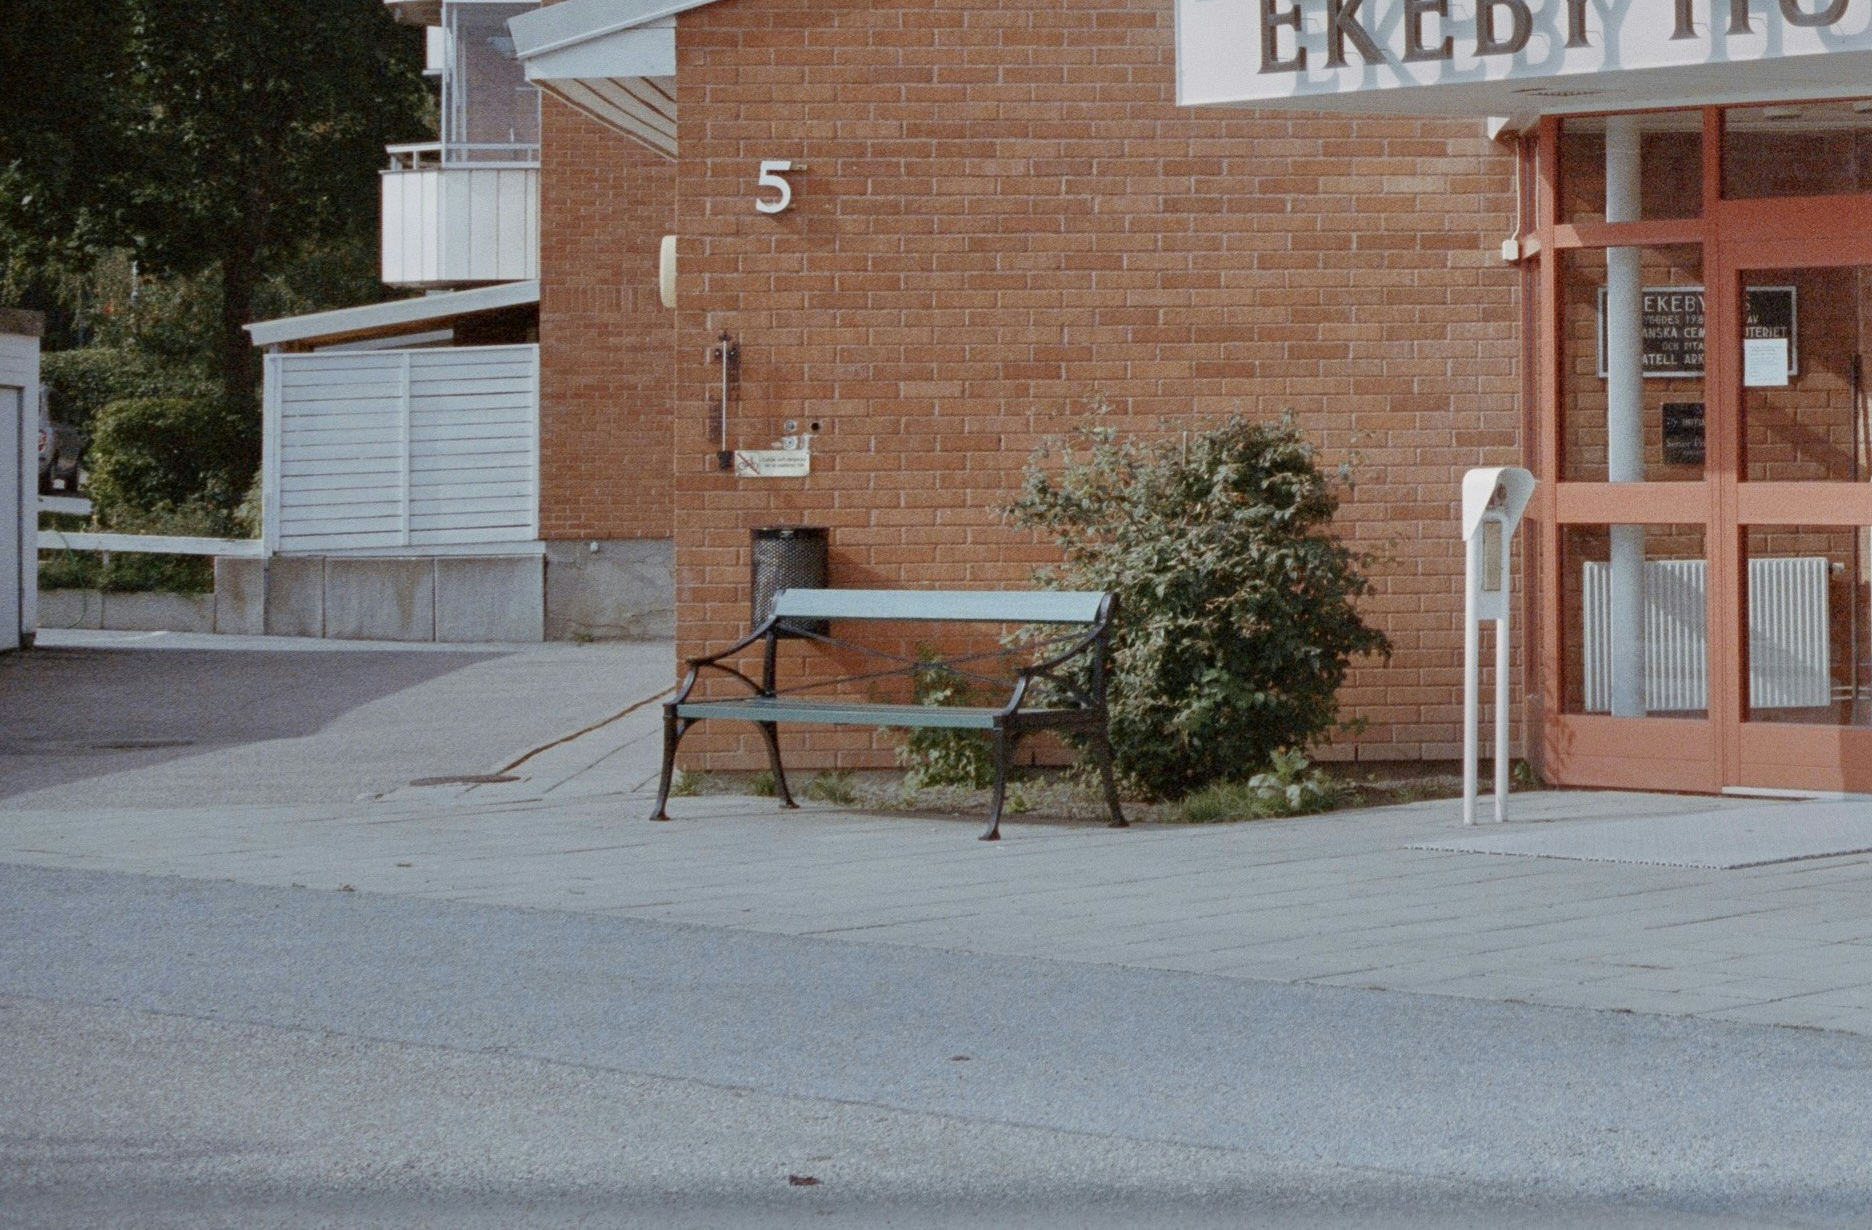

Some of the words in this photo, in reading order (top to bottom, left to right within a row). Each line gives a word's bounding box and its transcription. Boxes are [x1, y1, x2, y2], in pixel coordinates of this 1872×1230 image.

[755, 160, 792, 214] 5
[1642, 327, 1678, 338] ANSKA
[1642, 353, 1678, 365] ATELL
